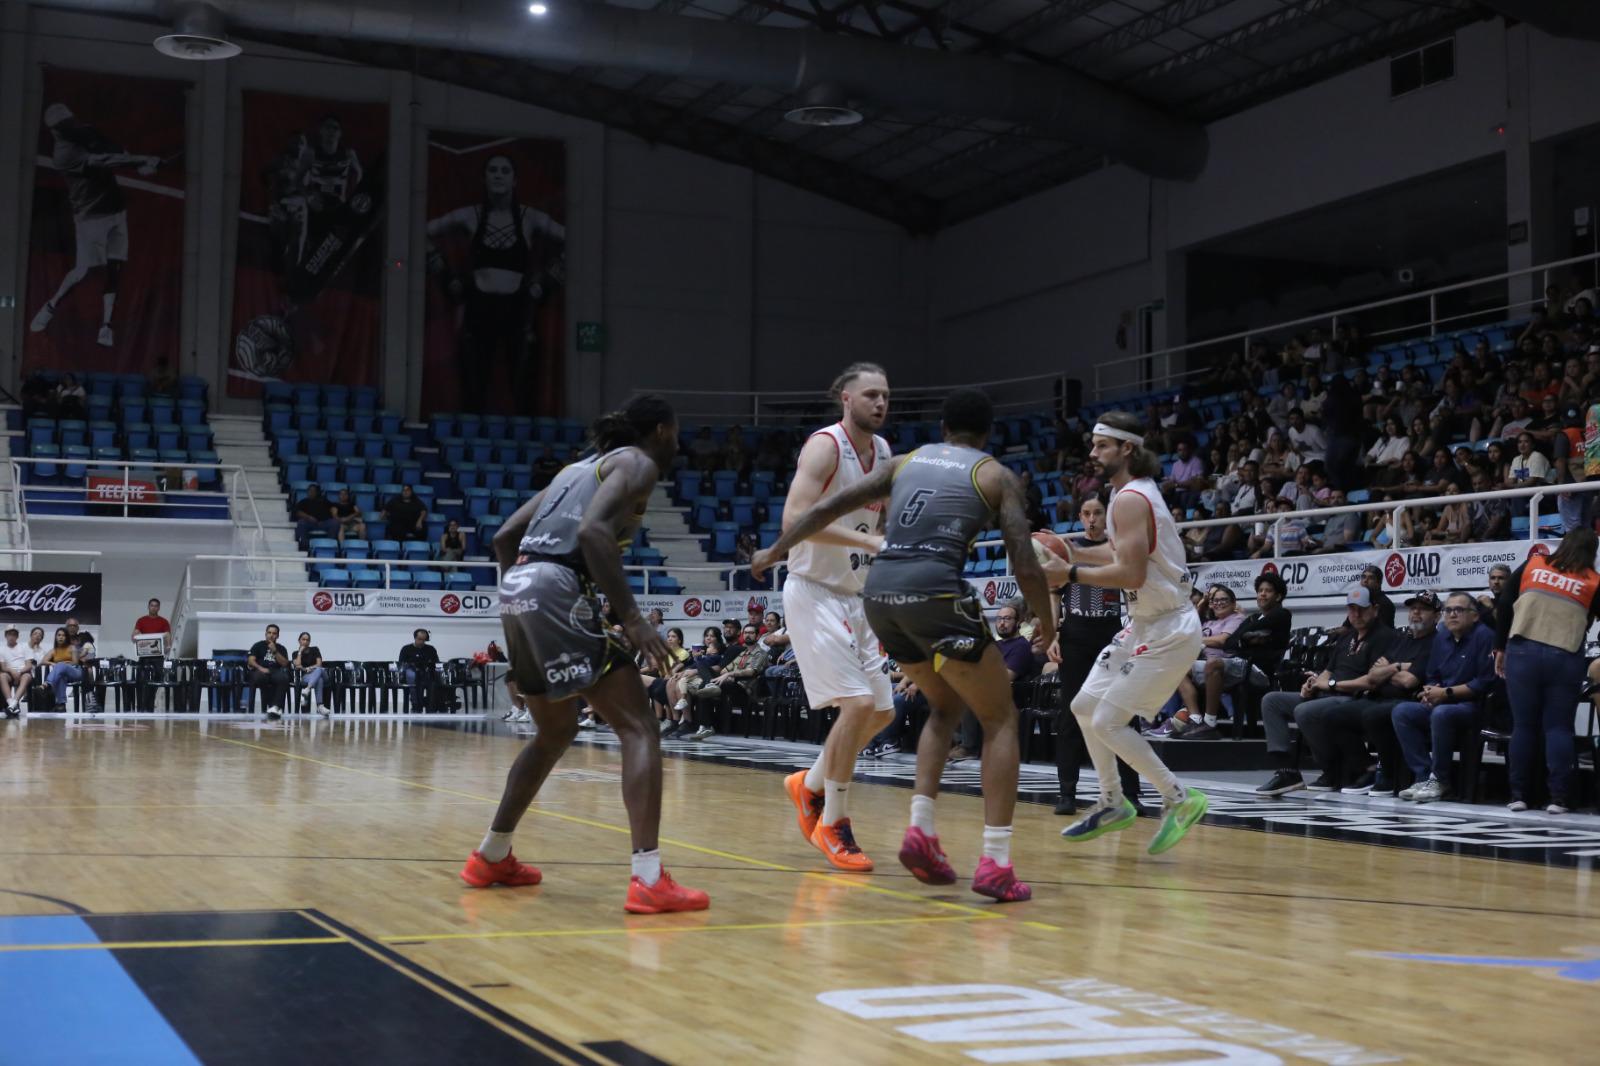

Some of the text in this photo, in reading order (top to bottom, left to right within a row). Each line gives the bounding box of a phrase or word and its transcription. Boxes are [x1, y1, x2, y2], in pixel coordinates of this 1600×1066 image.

[899, 488, 938, 528] 5
[1407, 552, 1441, 577] UAD
[1451, 553, 1516, 565] SIEMPRE GRANDES
[1281, 563, 1309, 584] CID
[1456, 566, 1486, 576] SIEMPRE
[997, 582, 1018, 599] UAD
[1530, 568, 1586, 596] TECATE
[334, 593, 365, 607] UAD
[462, 596, 492, 609] CID
[703, 599, 721, 613] CID
[546, 662, 593, 684] Gypsi
